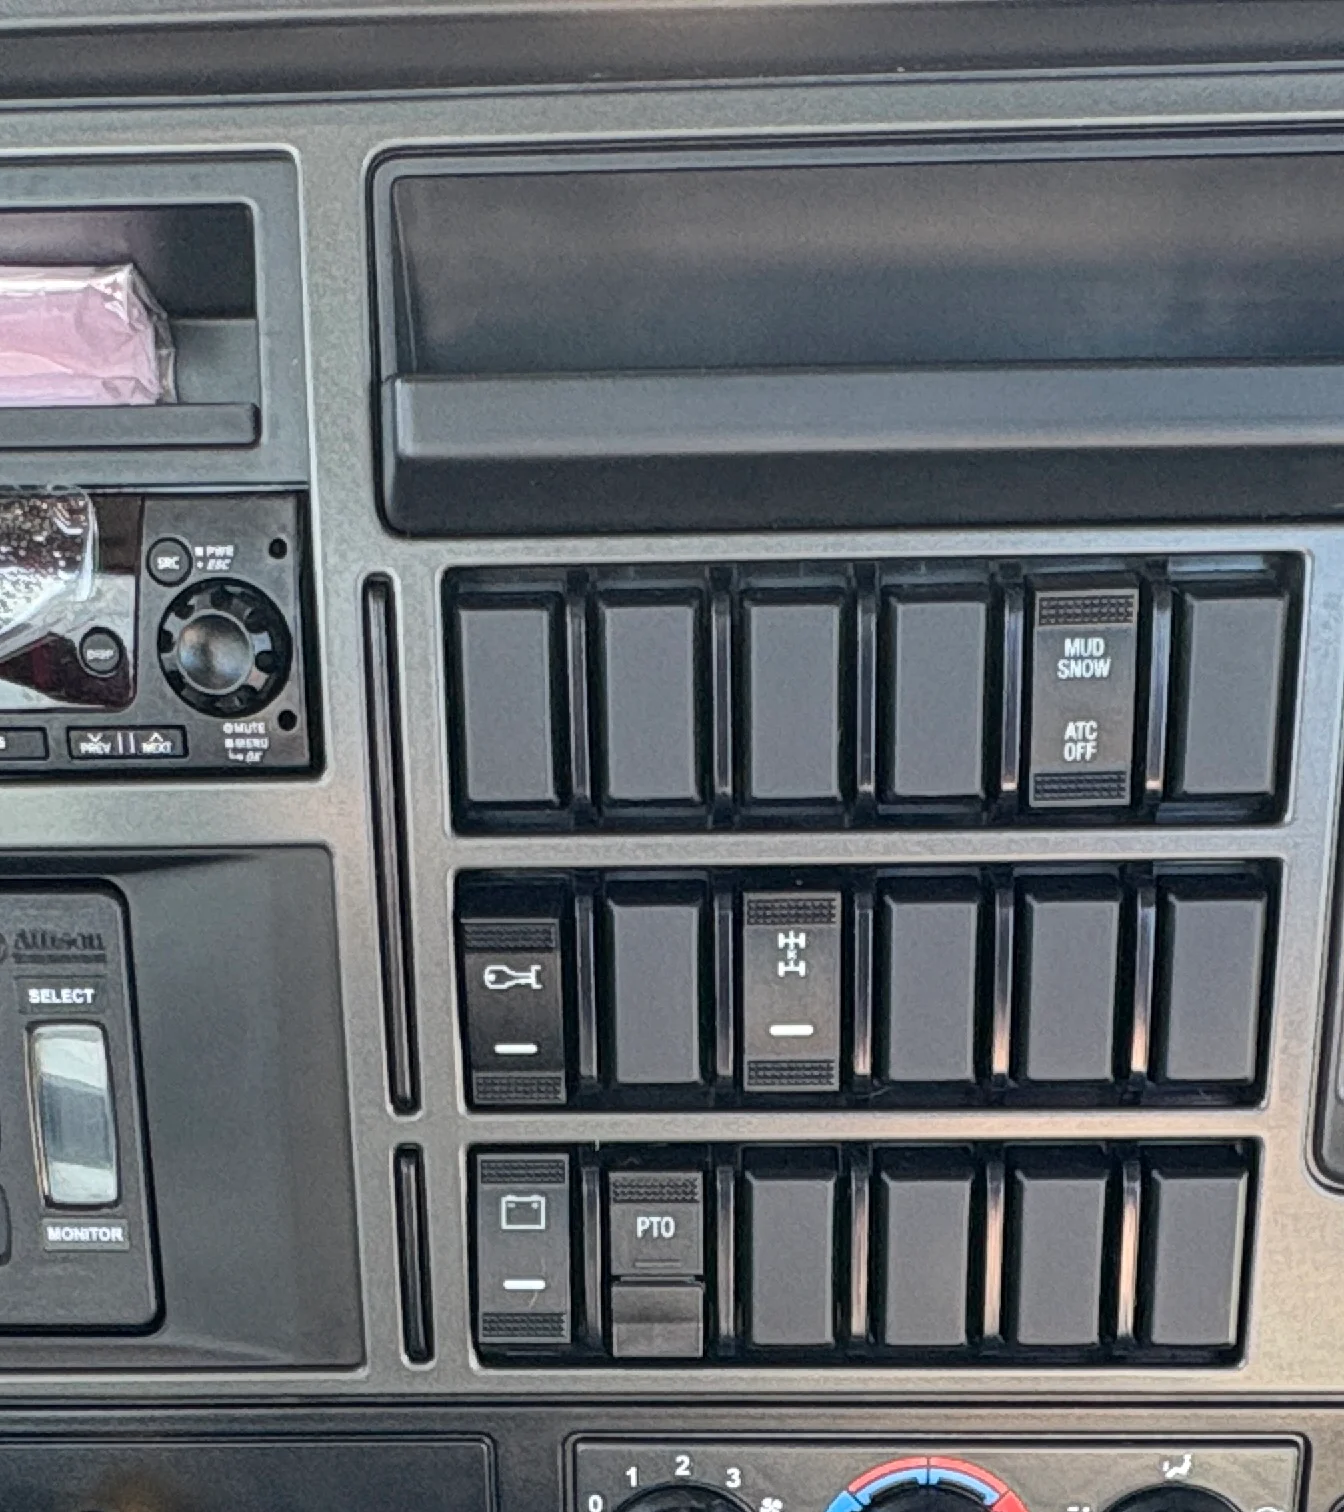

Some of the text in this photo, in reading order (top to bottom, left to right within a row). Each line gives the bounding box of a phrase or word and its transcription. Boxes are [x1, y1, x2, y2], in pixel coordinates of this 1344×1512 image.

[156, 556, 180, 570] SRC
[206, 558, 232, 571] ESC
[1064, 637, 1105, 657] MUD
[1057, 658, 1112, 680] SNOW
[1064, 720, 1098, 741] ATC
[80, 742, 112, 754] PREV
[141, 741, 173, 754] NEXT
[1063, 742, 1098, 762] OFF
[28, 988, 95, 1004] SELECT
[47, 1226, 124, 1242] MONITOR
[636, 1216, 675, 1238] PTO
[675, 1455, 692, 1476] 2
[625, 1467, 639, 1488] 1
[725, 1468, 742, 1488] 3
